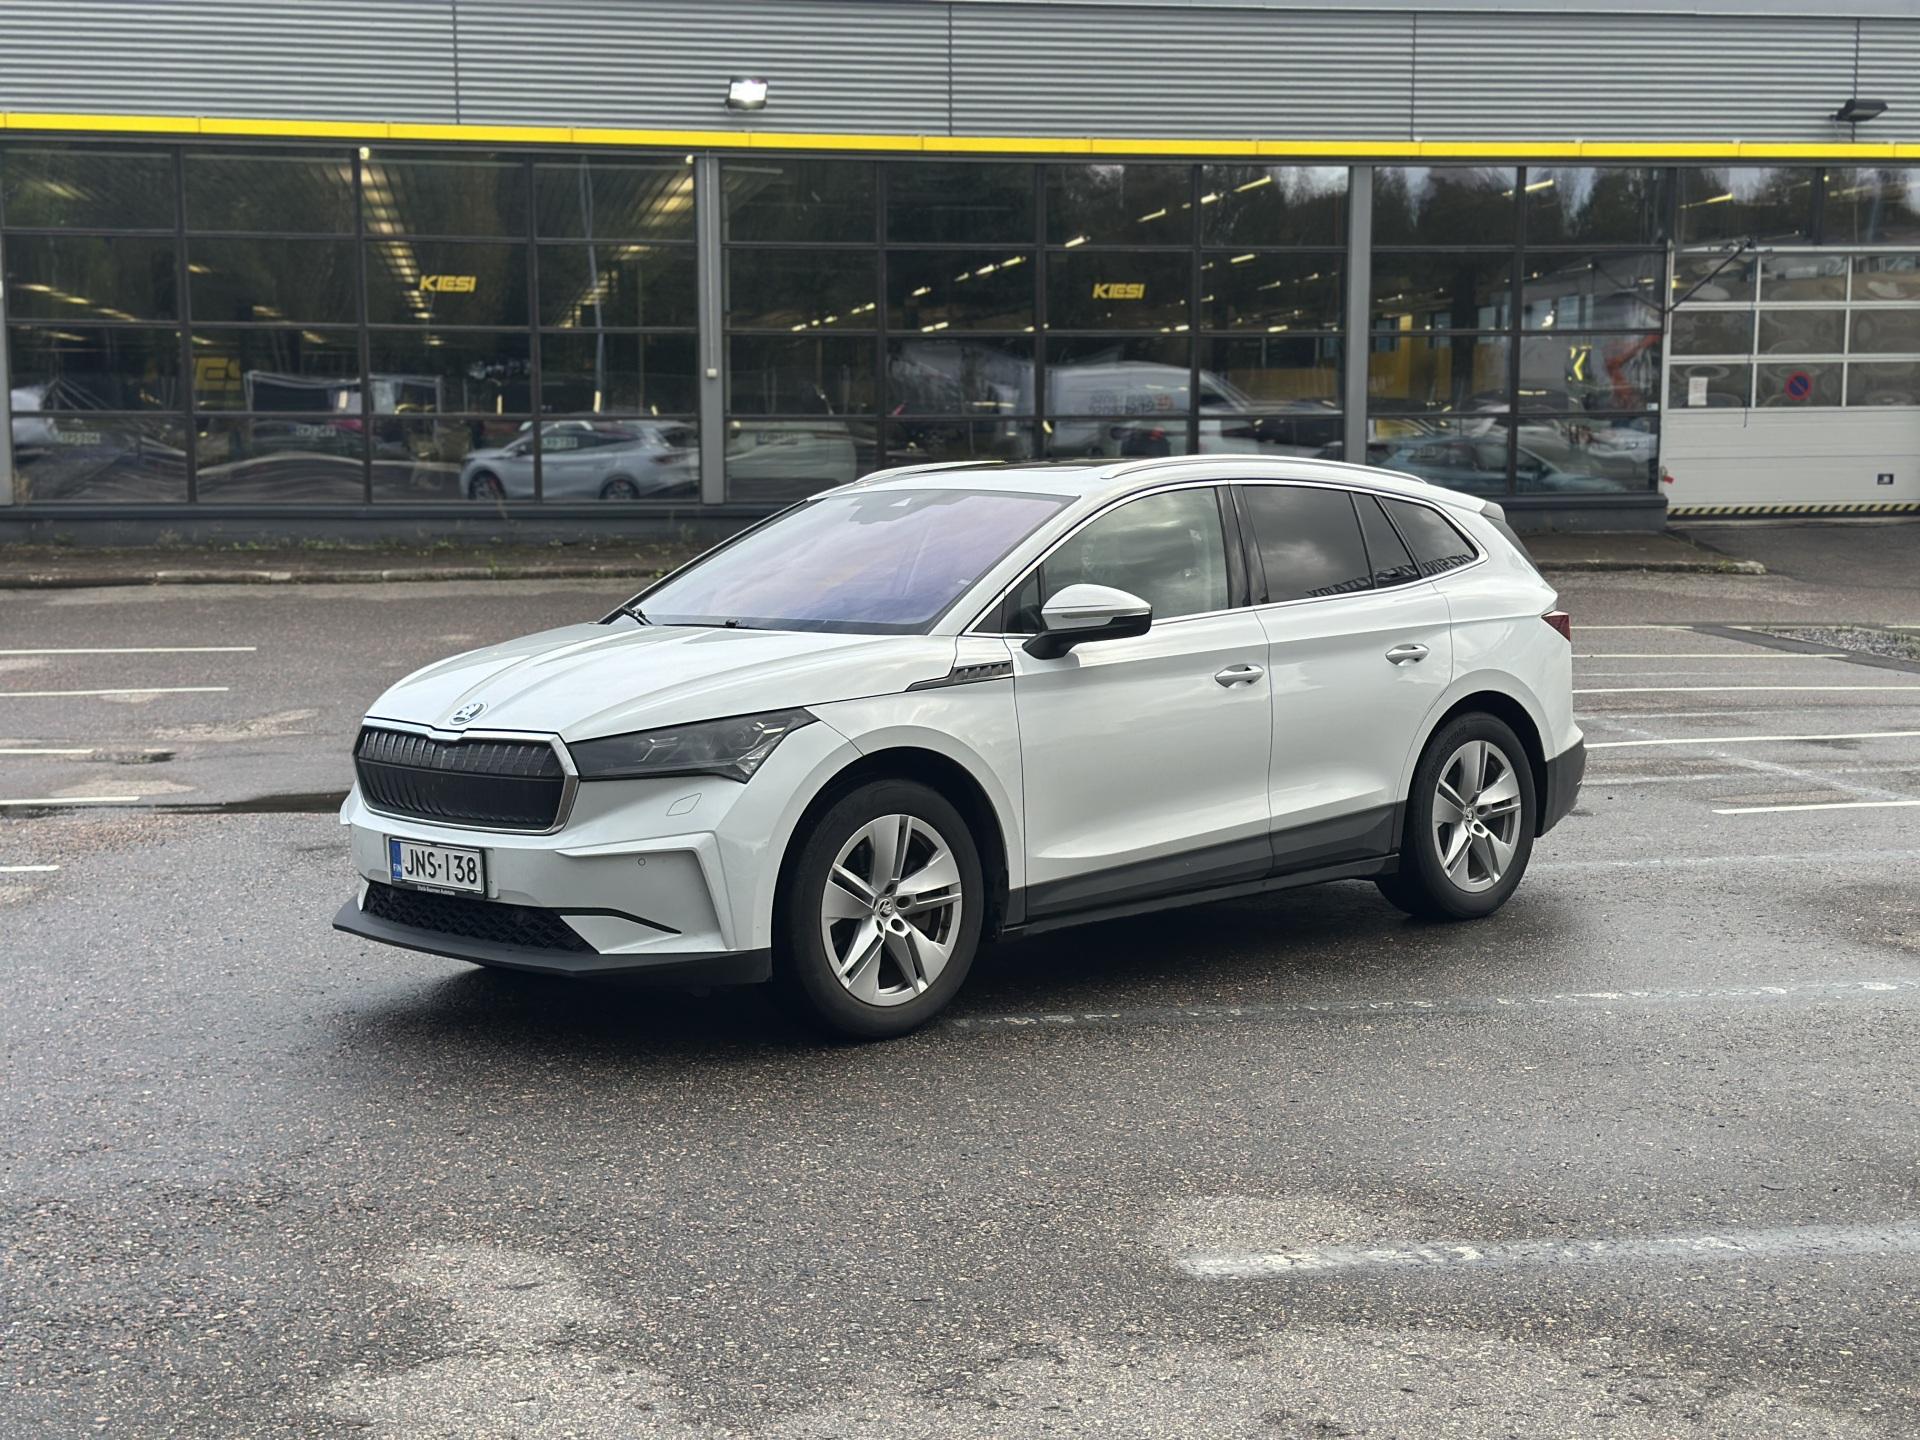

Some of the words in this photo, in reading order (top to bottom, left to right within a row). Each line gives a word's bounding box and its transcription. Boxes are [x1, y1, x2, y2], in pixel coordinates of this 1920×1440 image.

[420, 275, 477, 292] KIESI
[1092, 283, 1146, 299] KIESI
[405, 848, 477, 884] JNS-138
